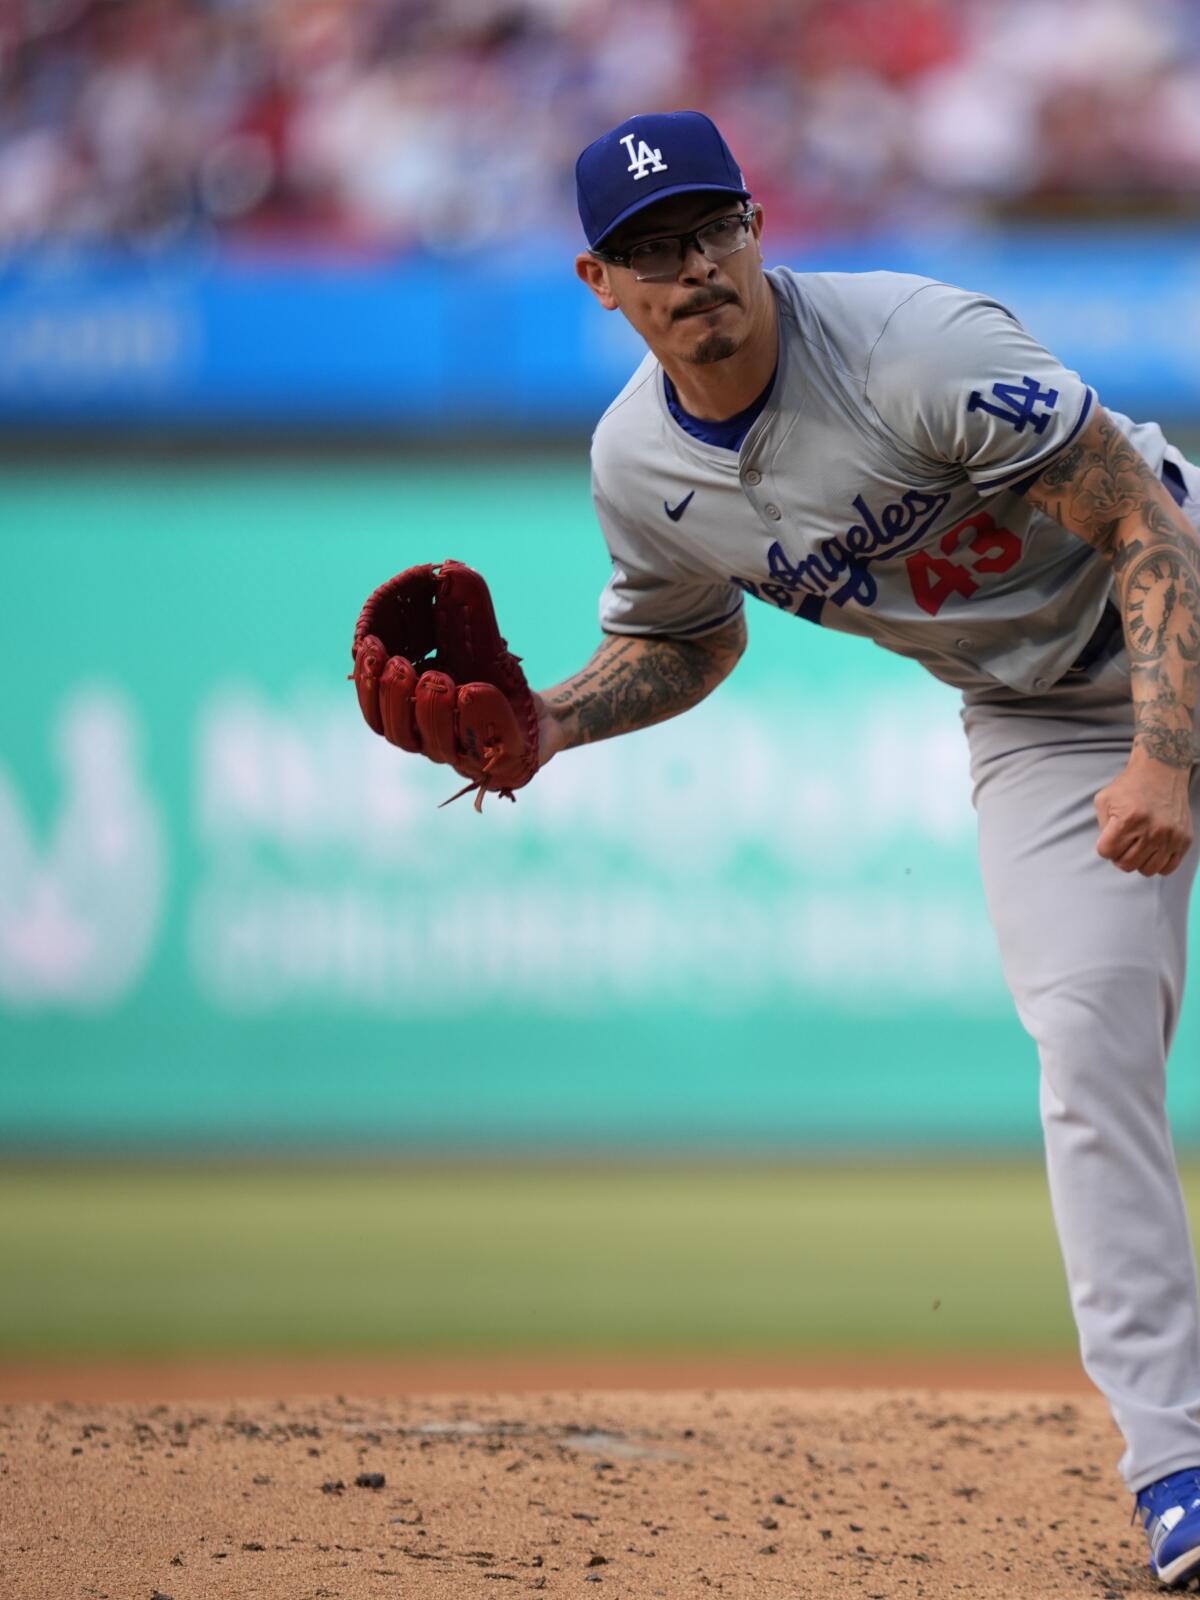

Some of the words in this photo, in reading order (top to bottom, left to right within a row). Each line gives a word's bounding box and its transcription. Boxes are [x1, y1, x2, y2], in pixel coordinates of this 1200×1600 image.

[619, 133, 668, 181] LA
[967, 375, 1059, 435] LA
[767, 489, 951, 608] Angeles
[905, 511, 1022, 617] 43
